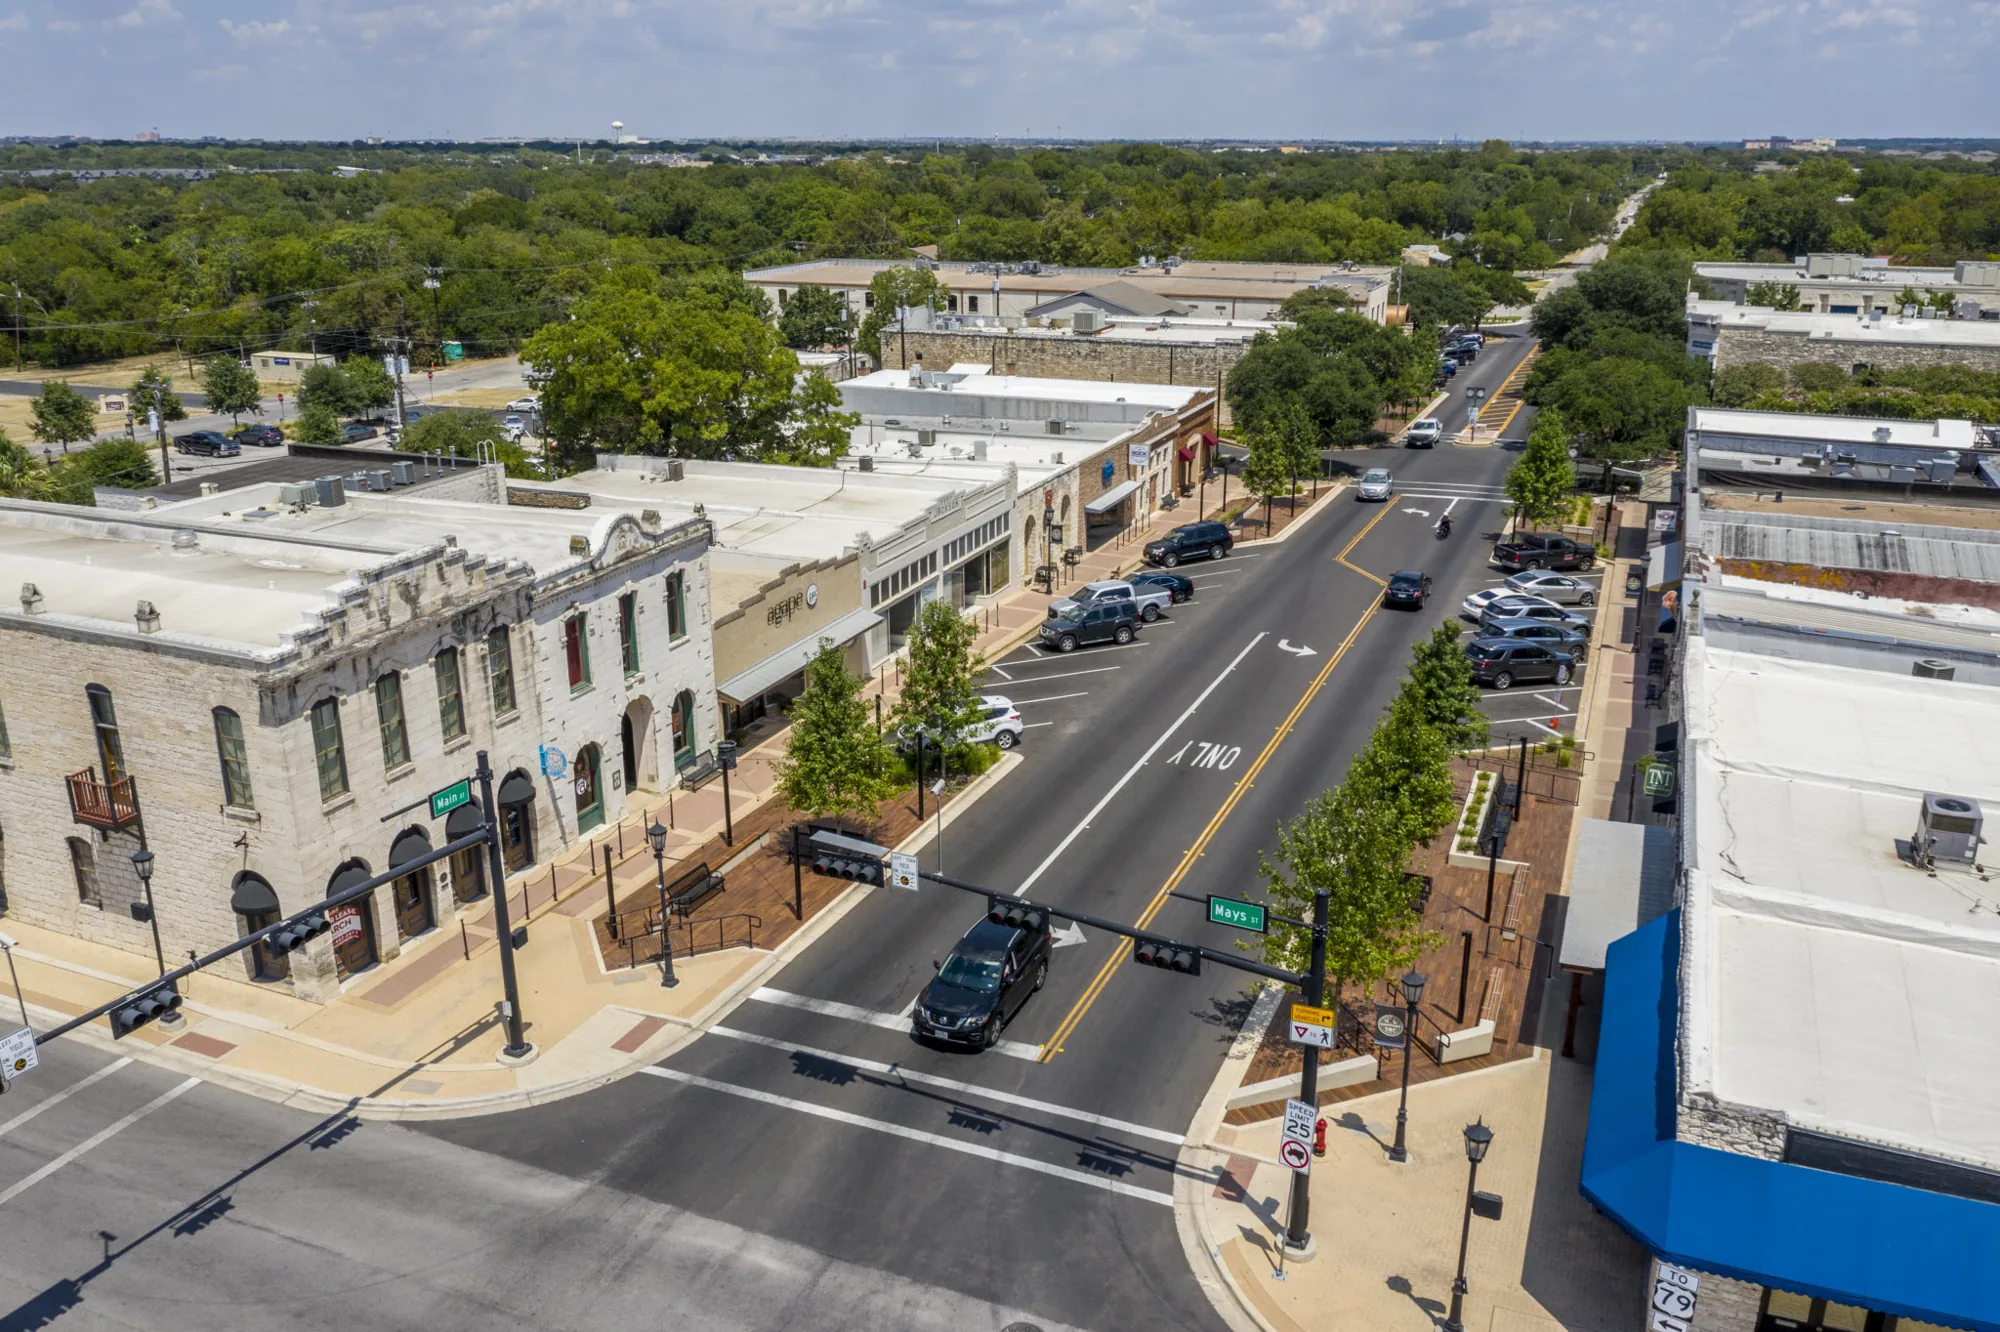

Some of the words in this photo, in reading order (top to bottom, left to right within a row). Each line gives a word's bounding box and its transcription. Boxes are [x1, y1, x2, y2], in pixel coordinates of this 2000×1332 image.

[767, 592, 804, 627] agape
[1166, 740, 1241, 770] ONLY
[1649, 769, 1673, 786] TNT
[437, 793, 457, 810] Main
[1215, 904, 1247, 921] Mays
[1251, 916, 1259, 924] ST
[10, 1041, 24, 1052] YIELD
[1288, 1103, 1314, 1118] SPEED
[1290, 1111, 1310, 1124] LIMIT
[1287, 1119, 1310, 1138] 25
[1670, 1270, 1688, 1285] TO
[1660, 1287, 1691, 1312] 79
